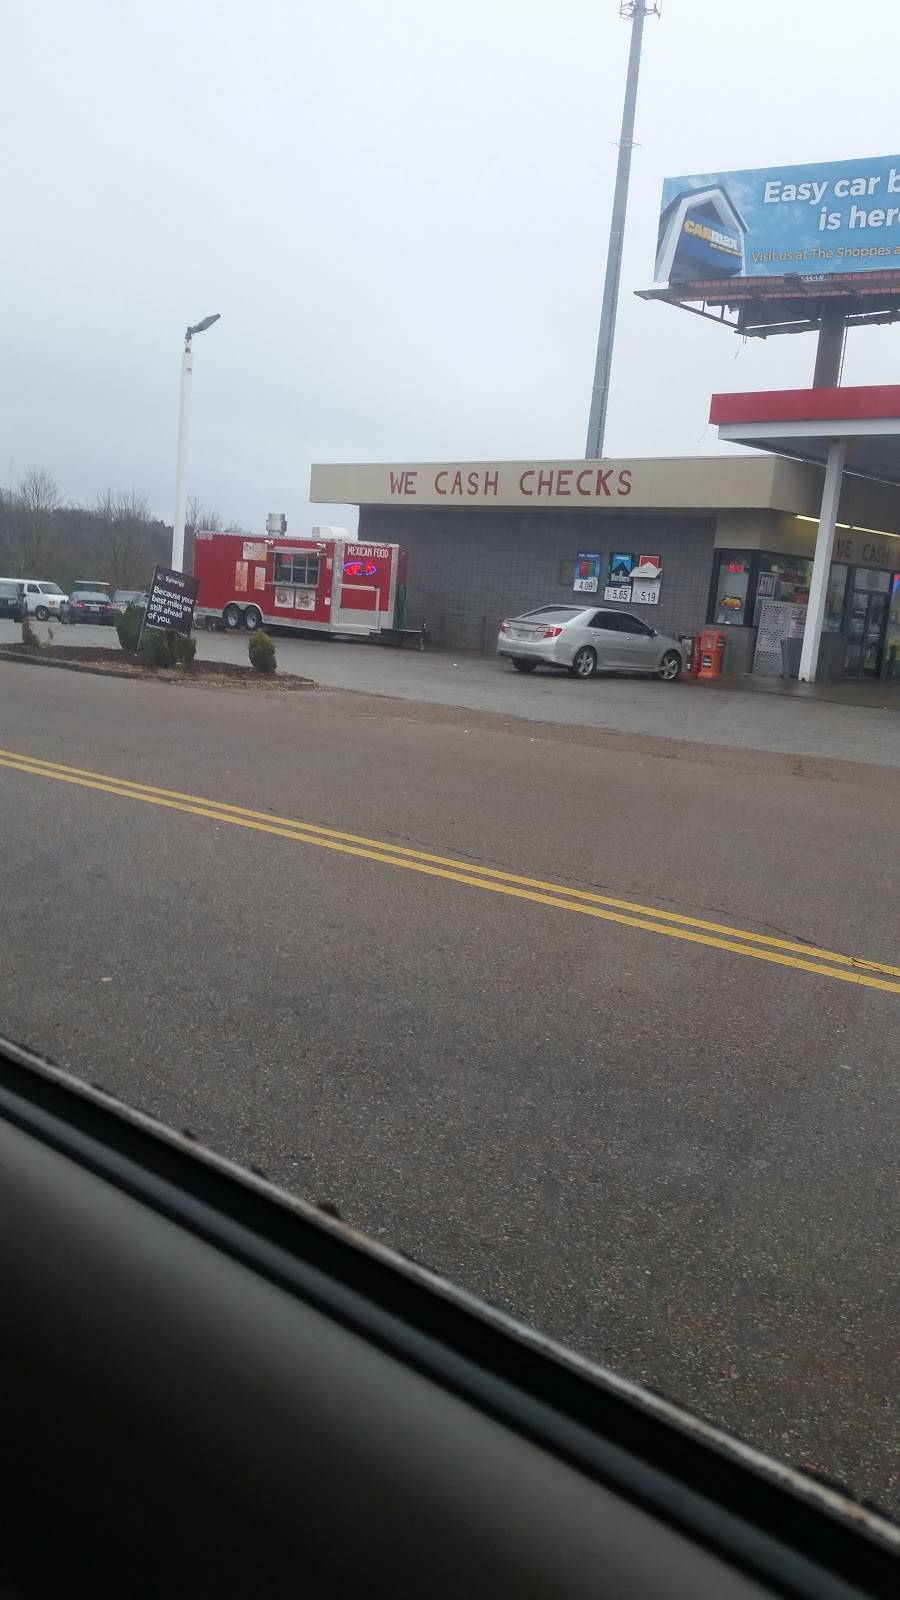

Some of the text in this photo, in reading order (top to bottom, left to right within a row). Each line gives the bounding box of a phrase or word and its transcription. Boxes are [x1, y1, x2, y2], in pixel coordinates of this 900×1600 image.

[763, 181, 827, 206] Easy
[833, 176, 881, 197] car
[818, 207, 840, 231] is
[752, 250, 776, 264] Visit
[780, 251, 793, 261] us
[795, 249, 808, 260] at
[810, 247, 833, 260] The
[836, 246, 890, 261] Shoppes
[389, 469, 633, 496] WE CASH CHECKS
[347, 545, 389, 558] MEXICAN FOOD
[836, 538, 851, 558] WE
[862, 543, 890, 565] CASH
[151, 594, 192, 613] best miles are
[153, 586, 194, 605] Because your
[612, 589, 628, 601] 5.65
[641, 591, 656, 602] 5.19
[150, 604, 183, 619] still ahead
[157, 615, 171, 625] you.
